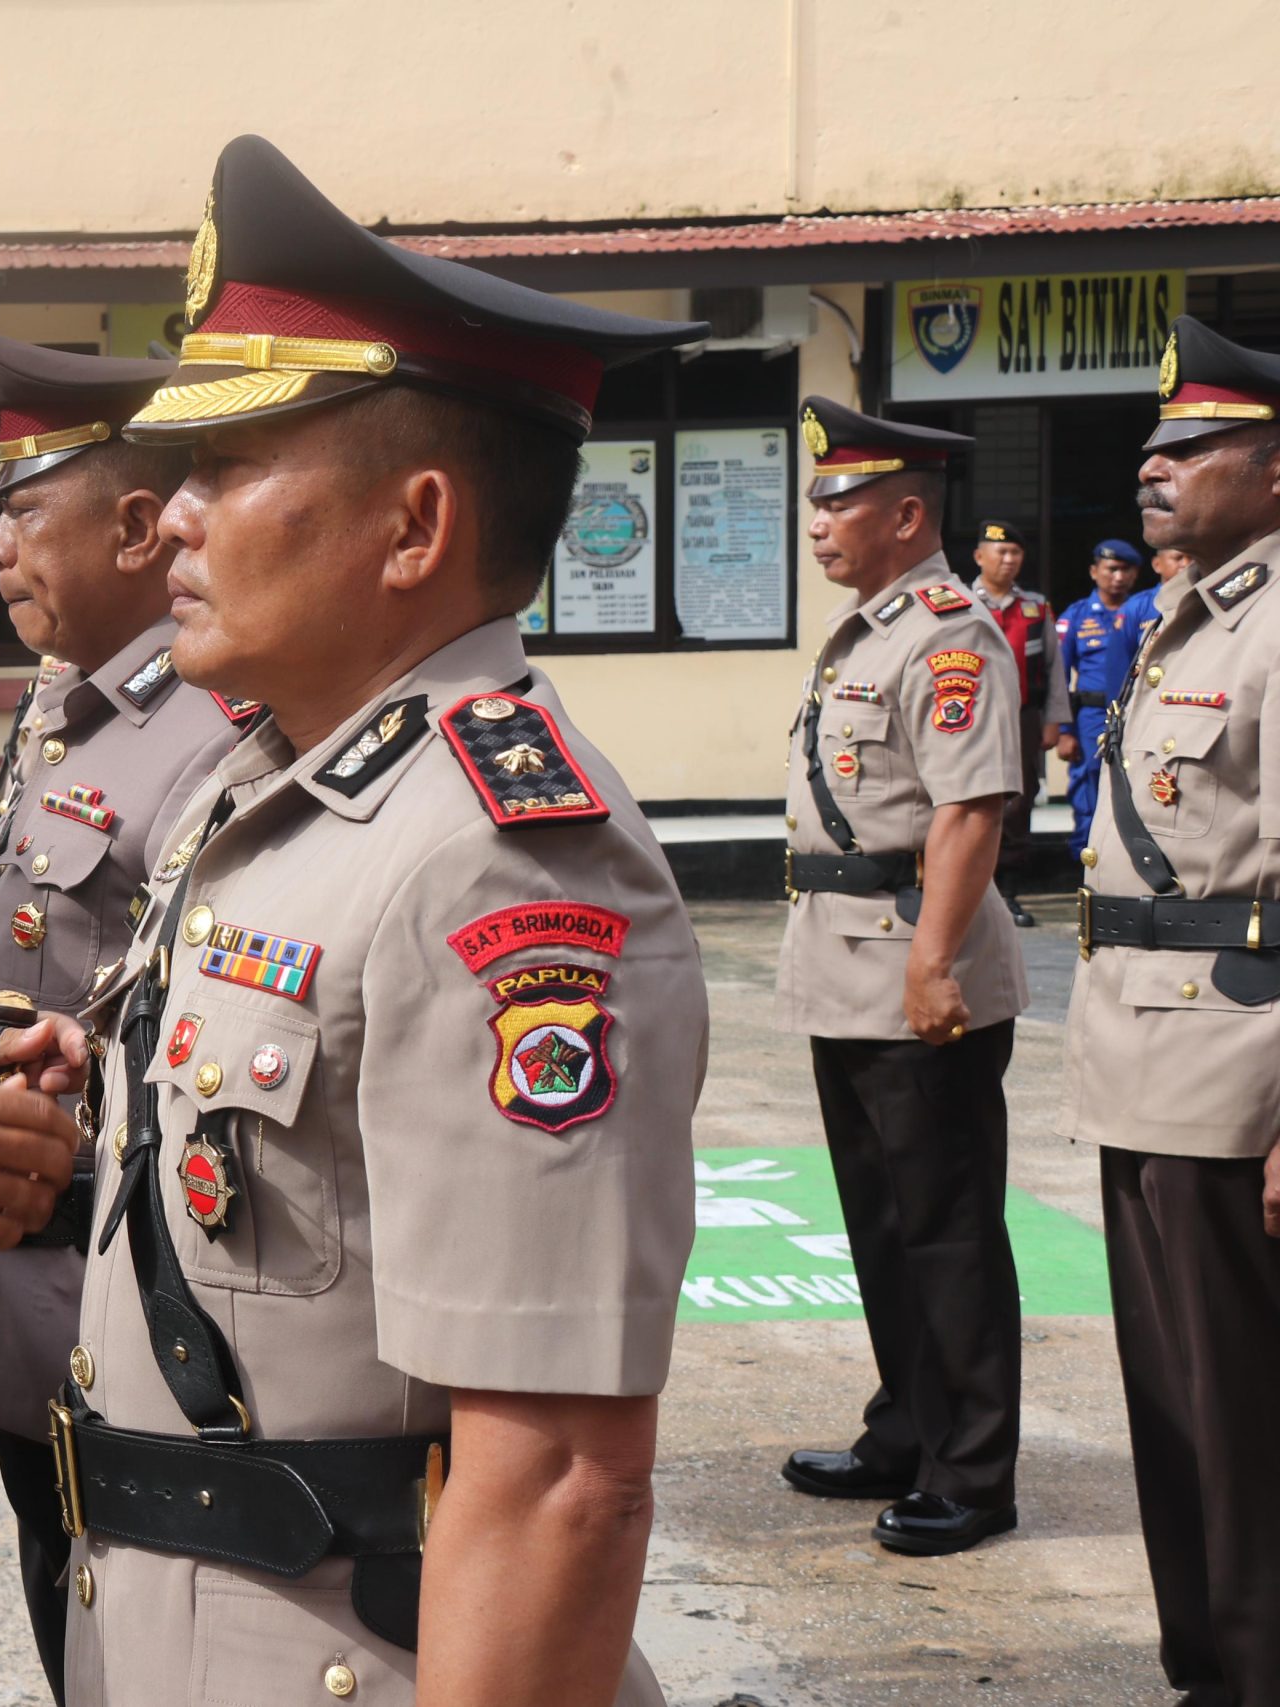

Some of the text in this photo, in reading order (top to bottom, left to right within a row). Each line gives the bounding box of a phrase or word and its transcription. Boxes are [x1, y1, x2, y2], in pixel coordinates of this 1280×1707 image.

[998, 273, 1170, 374] SAT BINMAS
[930, 652, 980, 668] POLRESTA
[937, 678, 973, 689] PAPUA
[464, 912, 613, 956] SAT BRIMOBDA
[496, 968, 601, 996] PAPUA
[681, 1274, 864, 1308] KUM
